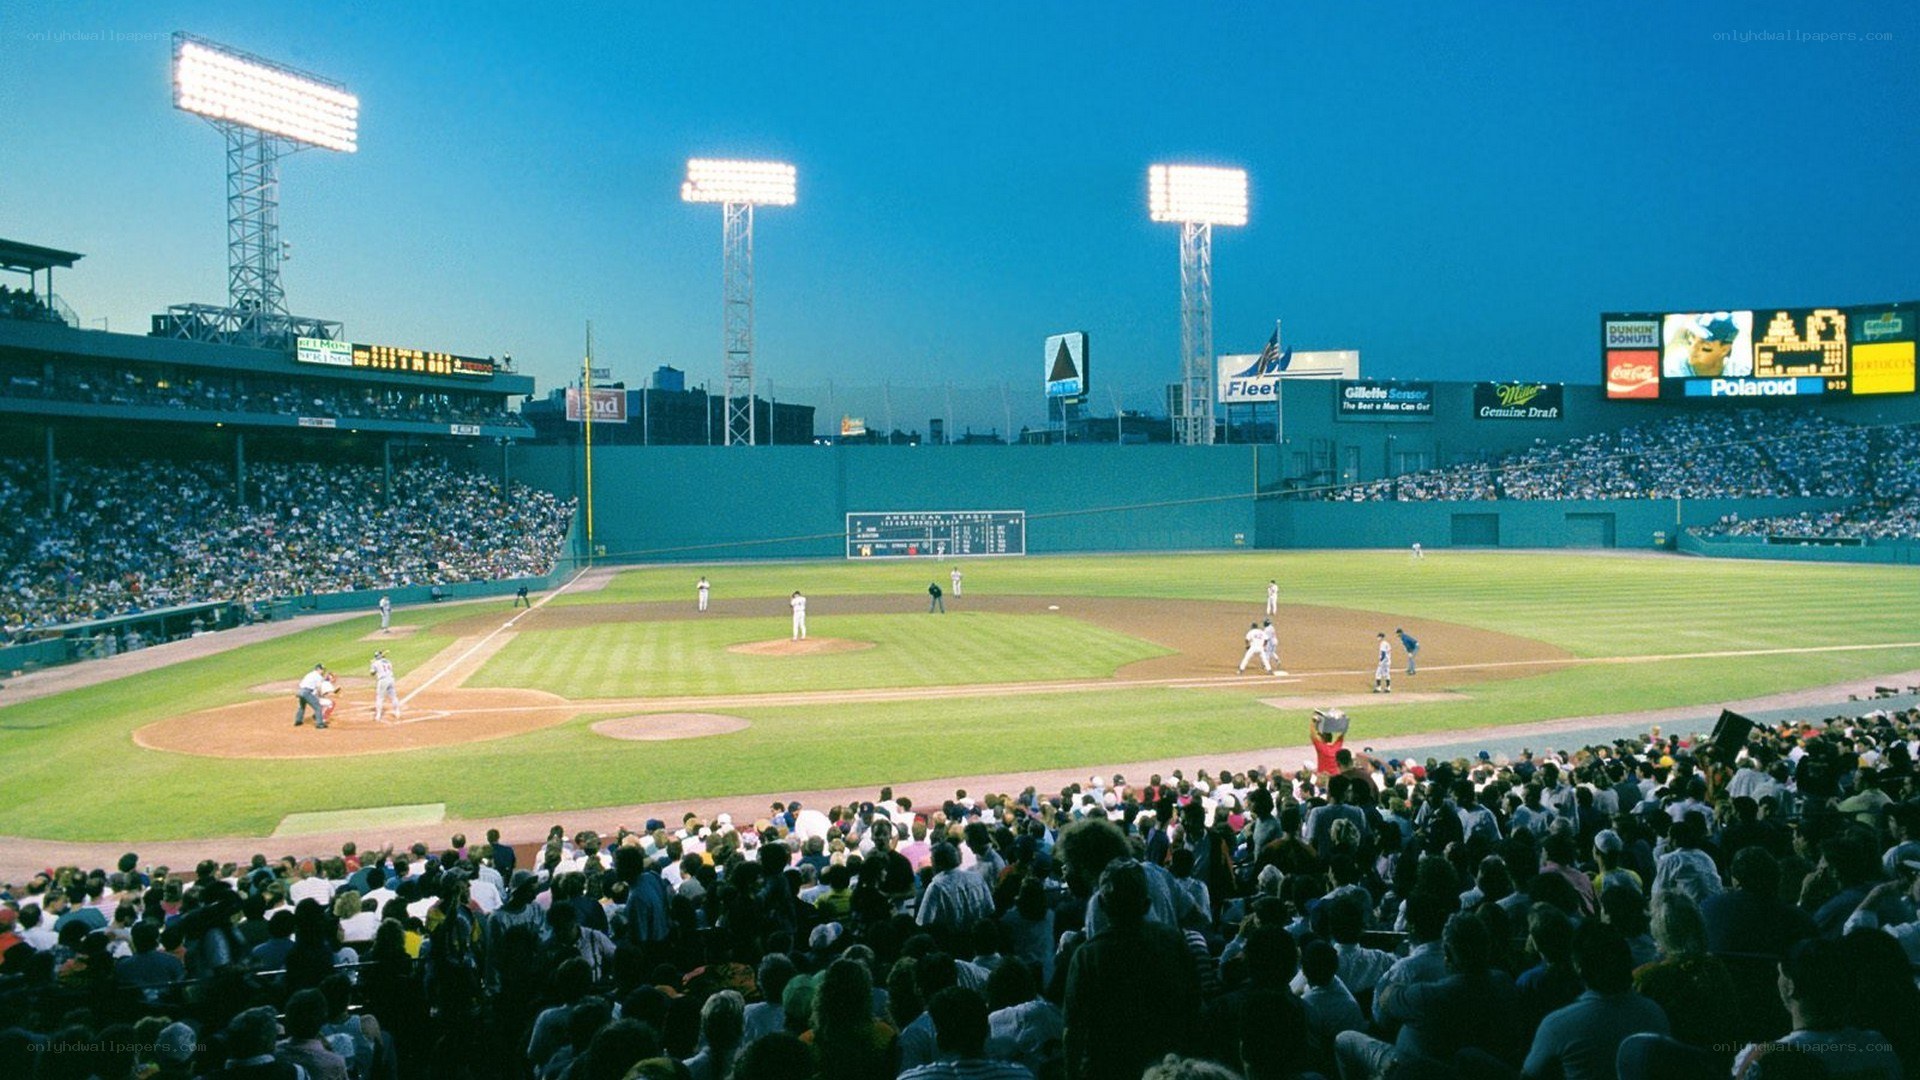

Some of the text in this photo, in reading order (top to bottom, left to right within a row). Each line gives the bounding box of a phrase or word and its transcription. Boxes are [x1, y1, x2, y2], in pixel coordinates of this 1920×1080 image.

[1609, 335, 1654, 344] DONUTS
[1228, 381, 1279, 396] Fleet
[1344, 386, 1428, 399] Gillette Sensor
[1711, 378, 1797, 397] Polaroid
[1496, 384, 1542, 405] Miller
[1343, 402, 1356, 410] The
[1358, 402, 1372, 410] Best
[1382, 402, 1399, 410] Man
[1401, 402, 1416, 410] Can
[1480, 406, 1558, 418] Genuine Draft
